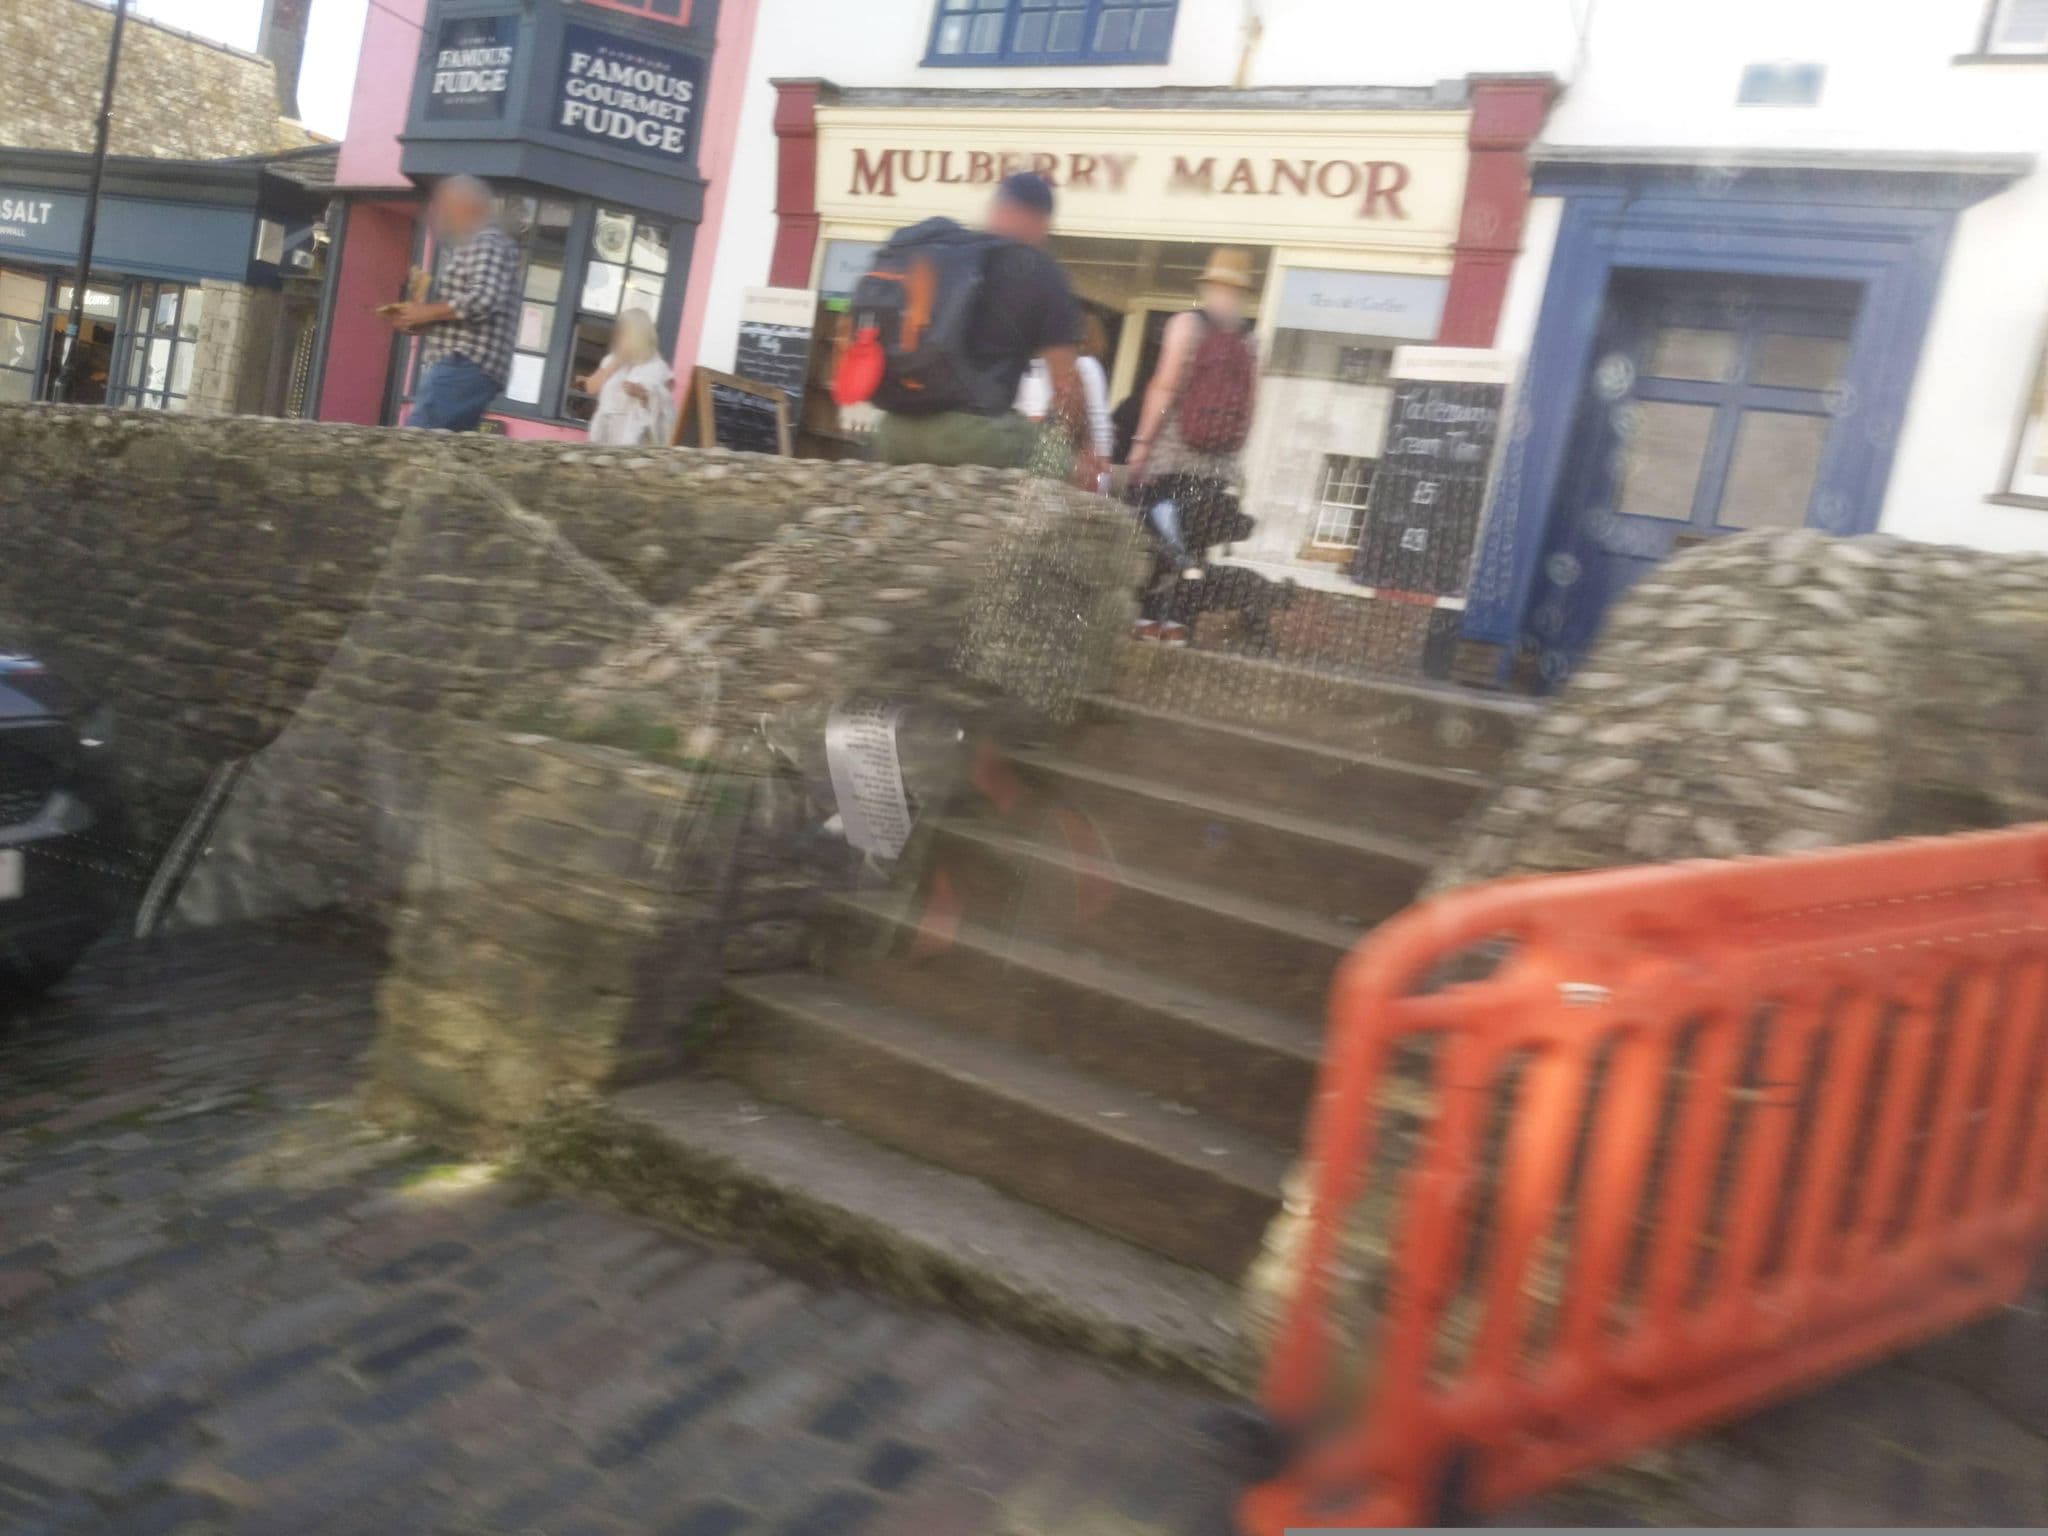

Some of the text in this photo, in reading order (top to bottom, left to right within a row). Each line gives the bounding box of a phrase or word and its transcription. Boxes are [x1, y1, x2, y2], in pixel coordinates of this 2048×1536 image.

[437, 46, 513, 69] FAMOUS
[568, 52, 693, 102] FAMOUS
[432, 69, 508, 94] FUDGE
[565, 78, 690, 123] GOURMET
[561, 99, 686, 153] FUDGE
[1166, 154, 1412, 219] MANOR
[2, 199, 52, 225] SALT
